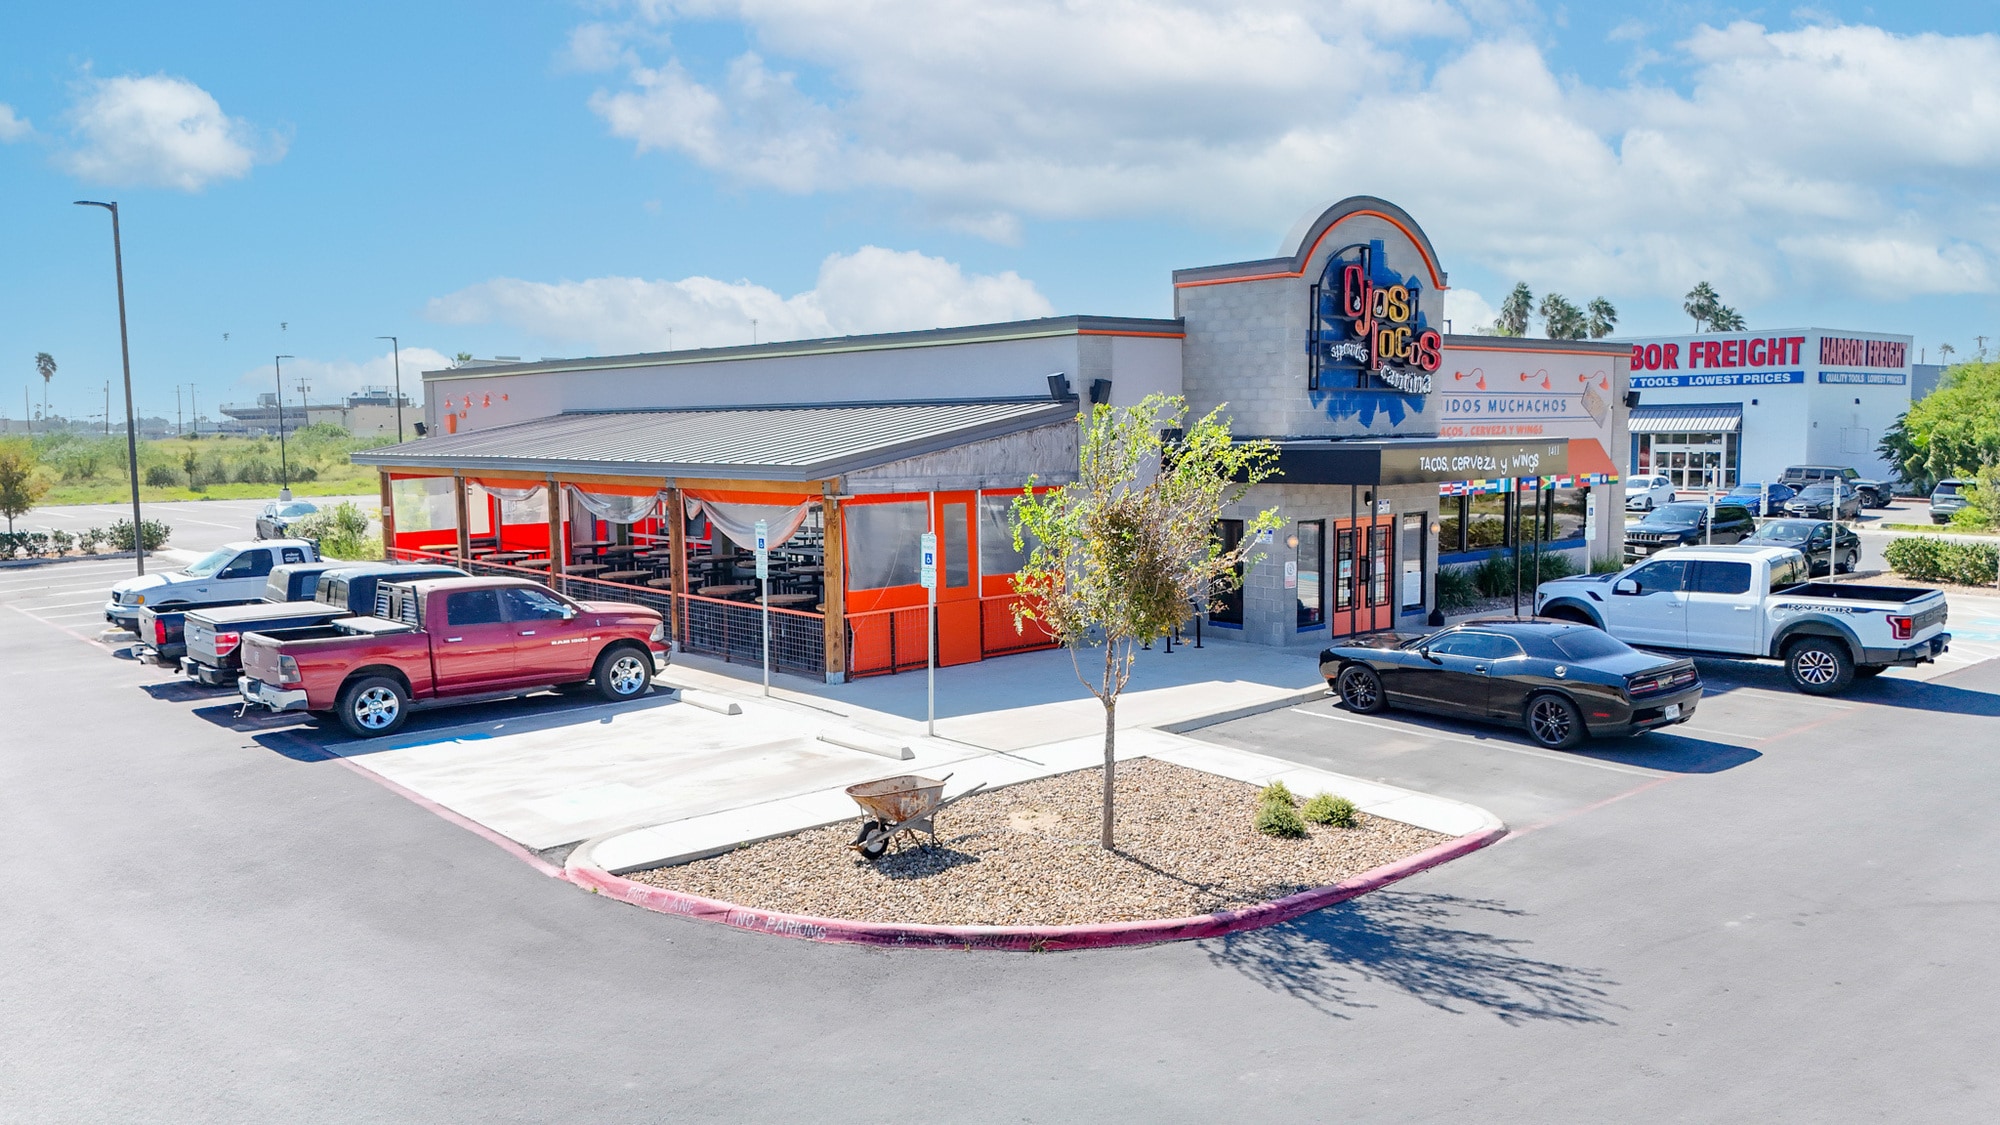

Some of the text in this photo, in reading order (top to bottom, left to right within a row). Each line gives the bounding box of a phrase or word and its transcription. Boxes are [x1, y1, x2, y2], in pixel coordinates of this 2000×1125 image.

[1344, 264, 1410, 337] Ojos
[1631, 336, 1805, 371] BOR FREIGHT
[1820, 336, 1907, 368] HARBOR FREIGHT
[1380, 364, 1433, 394] cantina
[1640, 377, 1679, 387] TOOLS
[1688, 374, 1739, 386] LOWEST
[1743, 372, 1791, 384] PRICES
[1825, 373, 1848, 383] QUALITY
[1848, 373, 1864, 383] TOOLS
[1867, 374, 1886, 383] LOWEST
[1445, 399, 1567, 414] IDOS MUCHACHOS
[1440, 424, 1544, 437] ACOS, CERVEZA Y WINGS
[1419, 456, 1449, 472] TACOS,
[1788, 603, 1853, 614] RAPTOR
[625, 887, 651, 904] FIRE
[735, 911, 827, 940] NO PARKING
